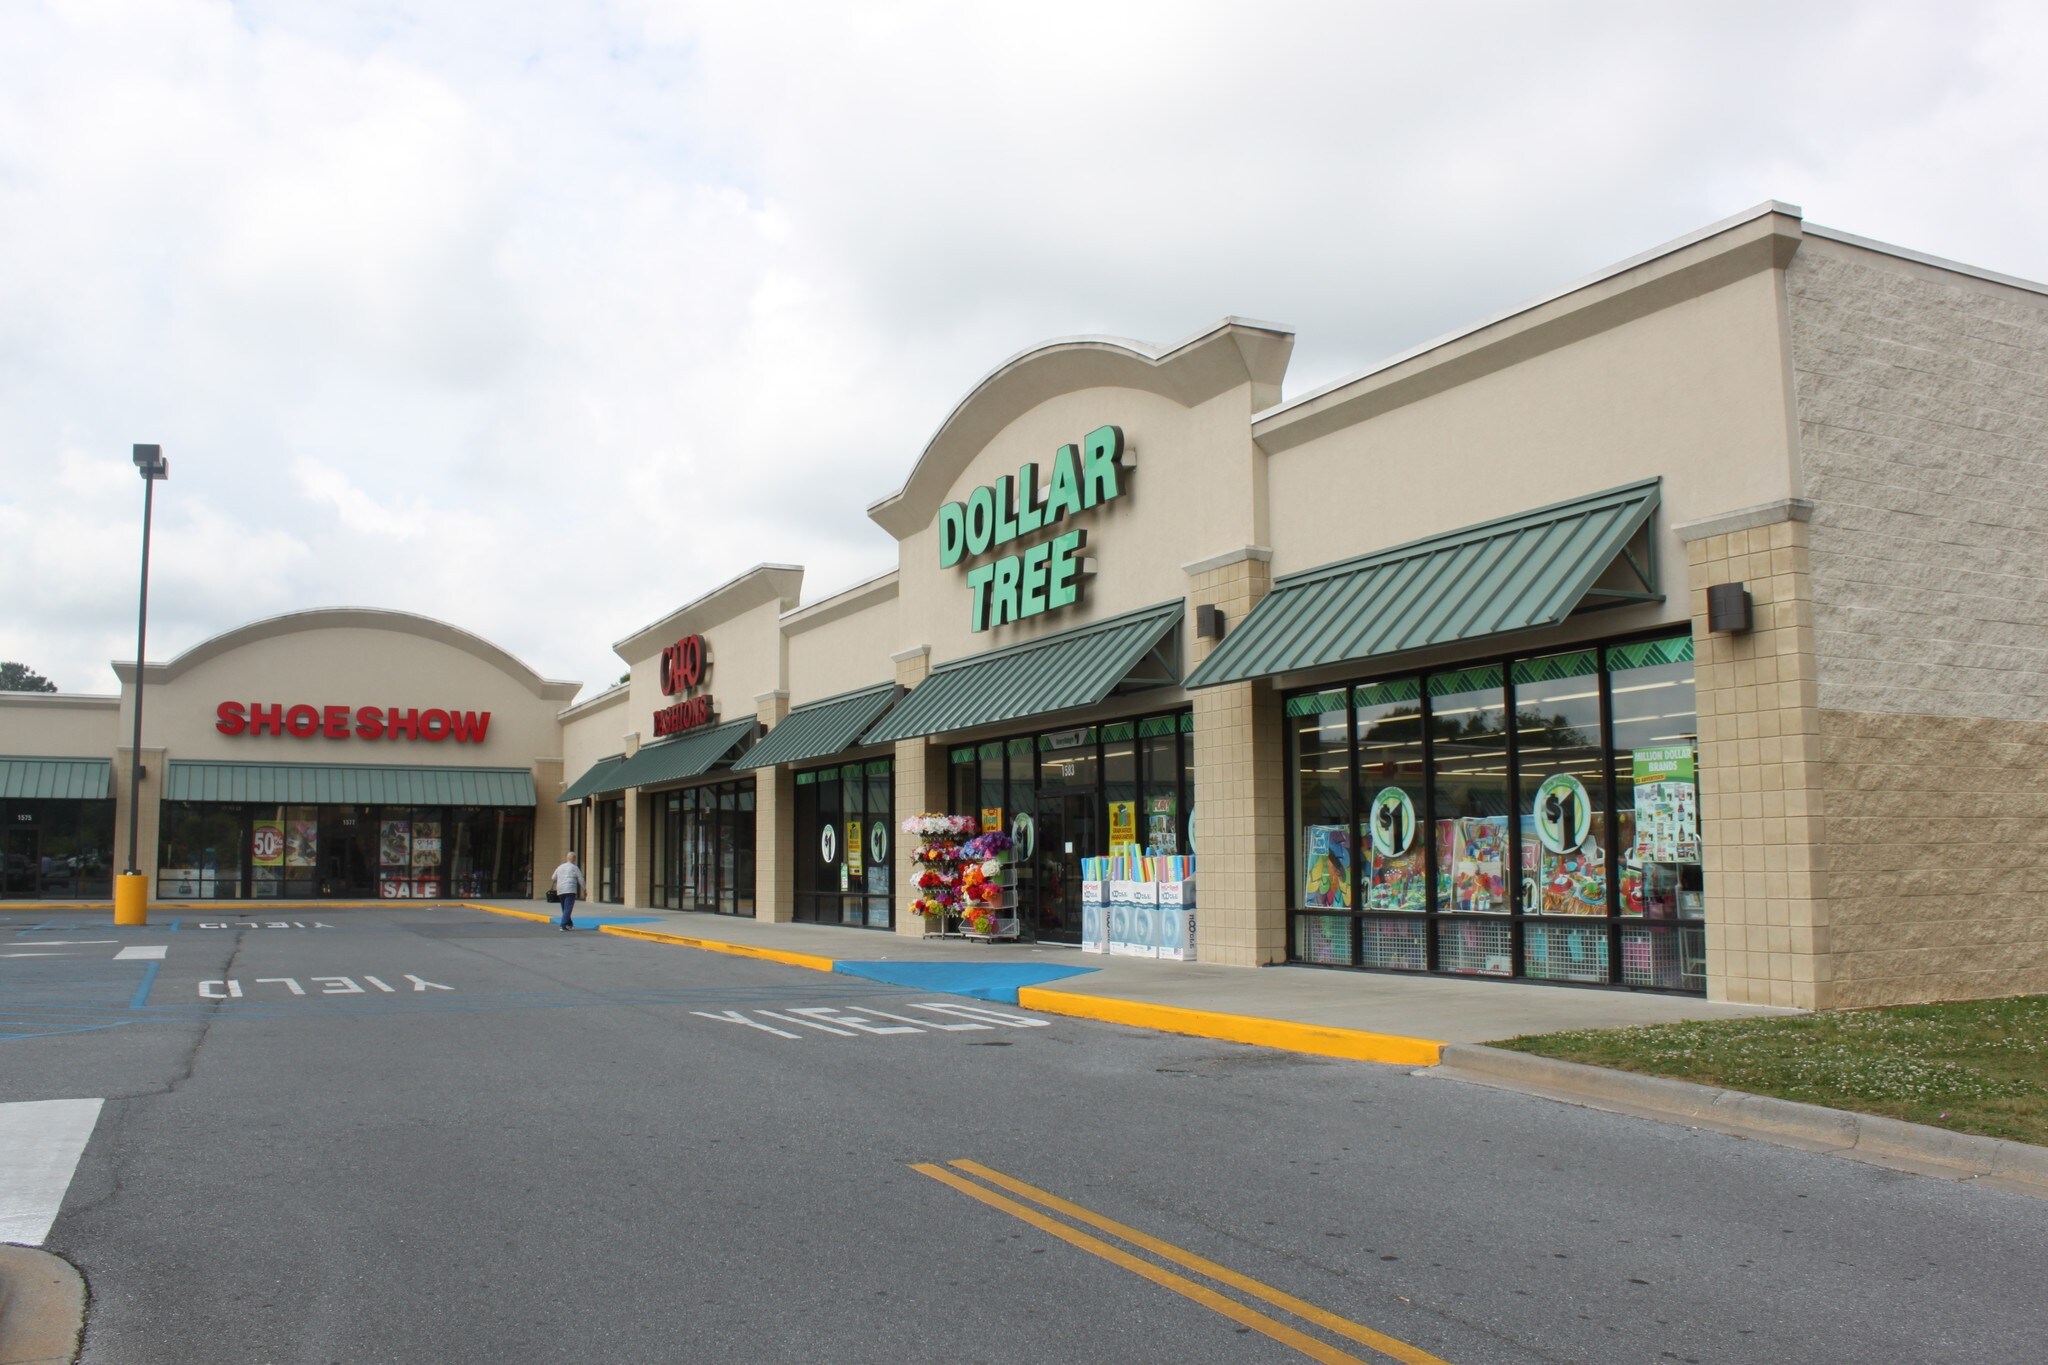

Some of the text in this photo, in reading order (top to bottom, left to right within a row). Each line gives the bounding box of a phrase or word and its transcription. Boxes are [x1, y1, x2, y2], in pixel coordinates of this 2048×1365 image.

[938, 425, 1125, 569] DOLLAR
[966, 529, 1088, 633] TREE
[660, 634, 707, 696] CATO
[653, 695, 713, 737] FASHIONS
[1061, 764, 1075, 776] 1583
[1635, 748, 1692, 761] MILLION DOLLAR
[1649, 761, 1677, 772] BRANDS
[1379, 801, 1404, 855] $1
[1545, 791, 1579, 851] $1
[825, 833, 832, 861] $1
[874, 831, 883, 861] $1
[1017, 824, 1028, 861] $1
[383, 881, 438, 898] SALE
[200, 921, 334, 929] YIELD
[198, 974, 455, 999] YIELD
[689, 1003, 1051, 1040] YIELD
